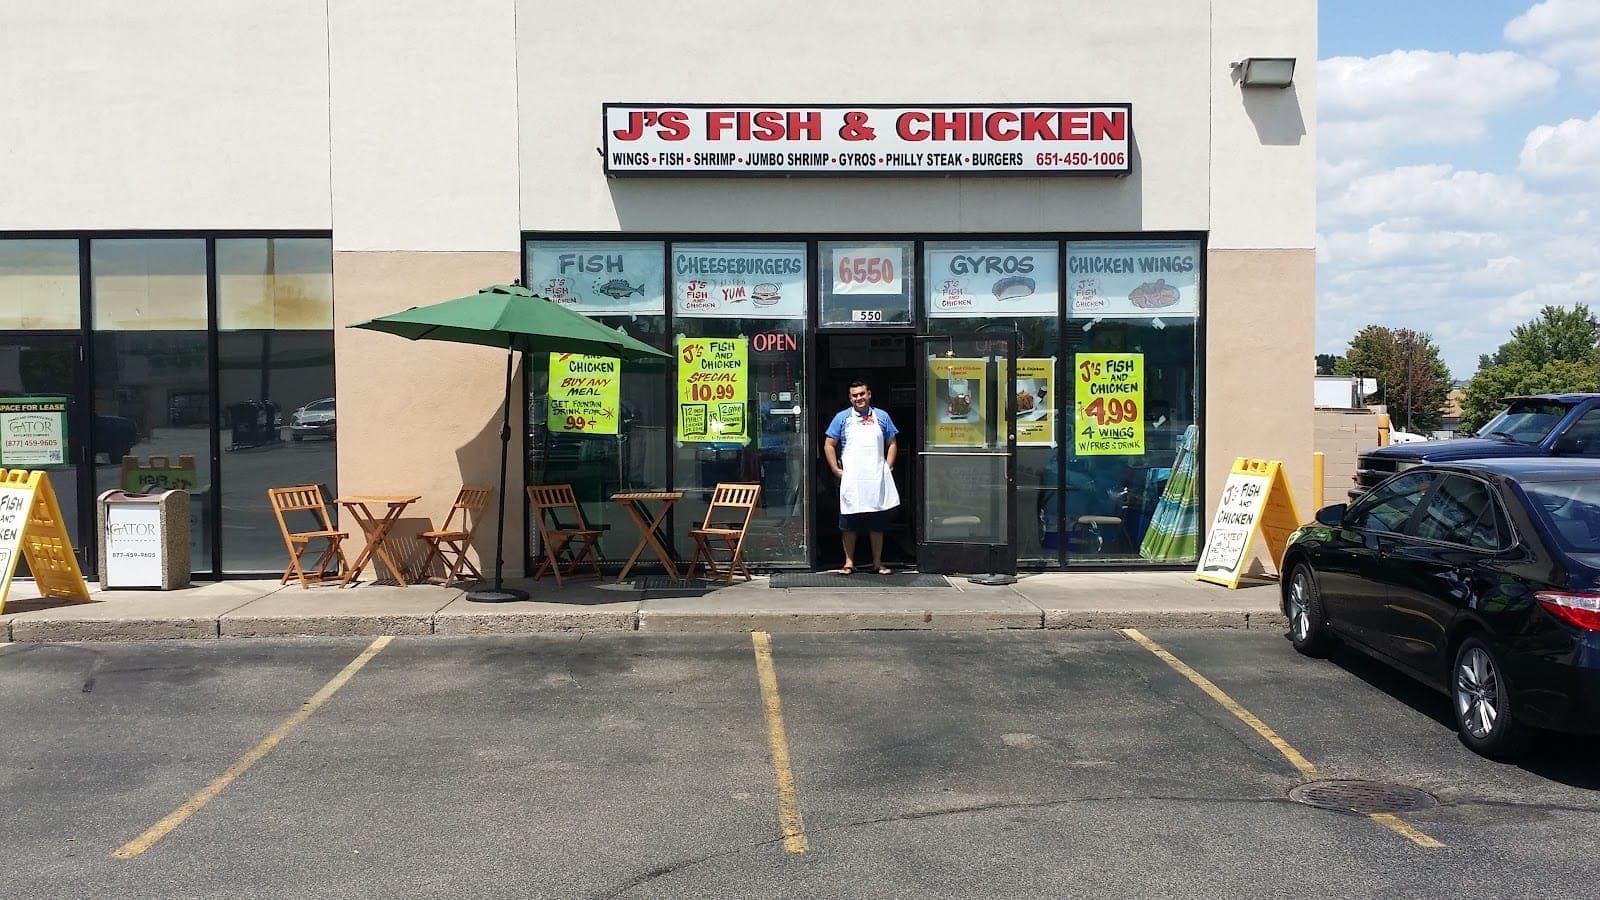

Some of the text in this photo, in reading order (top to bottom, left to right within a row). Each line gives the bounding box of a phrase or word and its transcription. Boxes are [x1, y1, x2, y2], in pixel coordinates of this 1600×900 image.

[613, 111, 1125, 141] J'S FISH & CHICKEN
[613, 152, 1125, 166] WINGS FISH SHRIMP JUMBO SHRIMP GYROS PHILLY STEAK BURGERS 651-450-1006
[559, 254, 624, 274] FISH
[677, 254, 801, 275] CHEESEBURGERS
[950, 255, 1035, 275] GYROS
[1068, 256, 1194, 274] CHICKEN WINGS
[839, 256, 894, 285] 6550
[545, 287, 569, 295] FISH
[686, 291, 708, 299] FISH
[721, 286, 746, 301] YUM
[942, 288, 963, 296] FISH
[1076, 288, 1097, 296] FISH
[941, 299, 972, 307] CHICKEN
[1076, 299, 1104, 307] CHICKEN
[860, 311, 881, 321] 550
[709, 342, 735, 352] FISH
[753, 333, 797, 351] OPEN
[715, 352, 733, 360] AND
[569, 360, 614, 373] CHICKEN
[701, 359, 741, 369] CHICKEN
[1106, 360, 1134, 373] FISH
[560, 377, 612, 388] BUY ANY
[688, 372, 738, 383] SPECIAL
[1110, 373, 1128, 382] AND
[567, 387, 601, 397] MEAL
[1090, 382, 1139, 395] CHICKEN
[40, 403, 65, 411] LEASE
[551, 400, 569, 409] GET
[552, 408, 580, 416] DRINK
[9, 420, 53, 433] GATOR
[1081, 426, 1134, 439] 4 WINGS
[24, 439, 58, 447] 459-9605
[1117, 440, 1140, 449] DRINK
[1240, 483, 1261, 497] FISH
[1217, 510, 1254, 525] CHICKEN
[110, 523, 156, 536] GATOR
